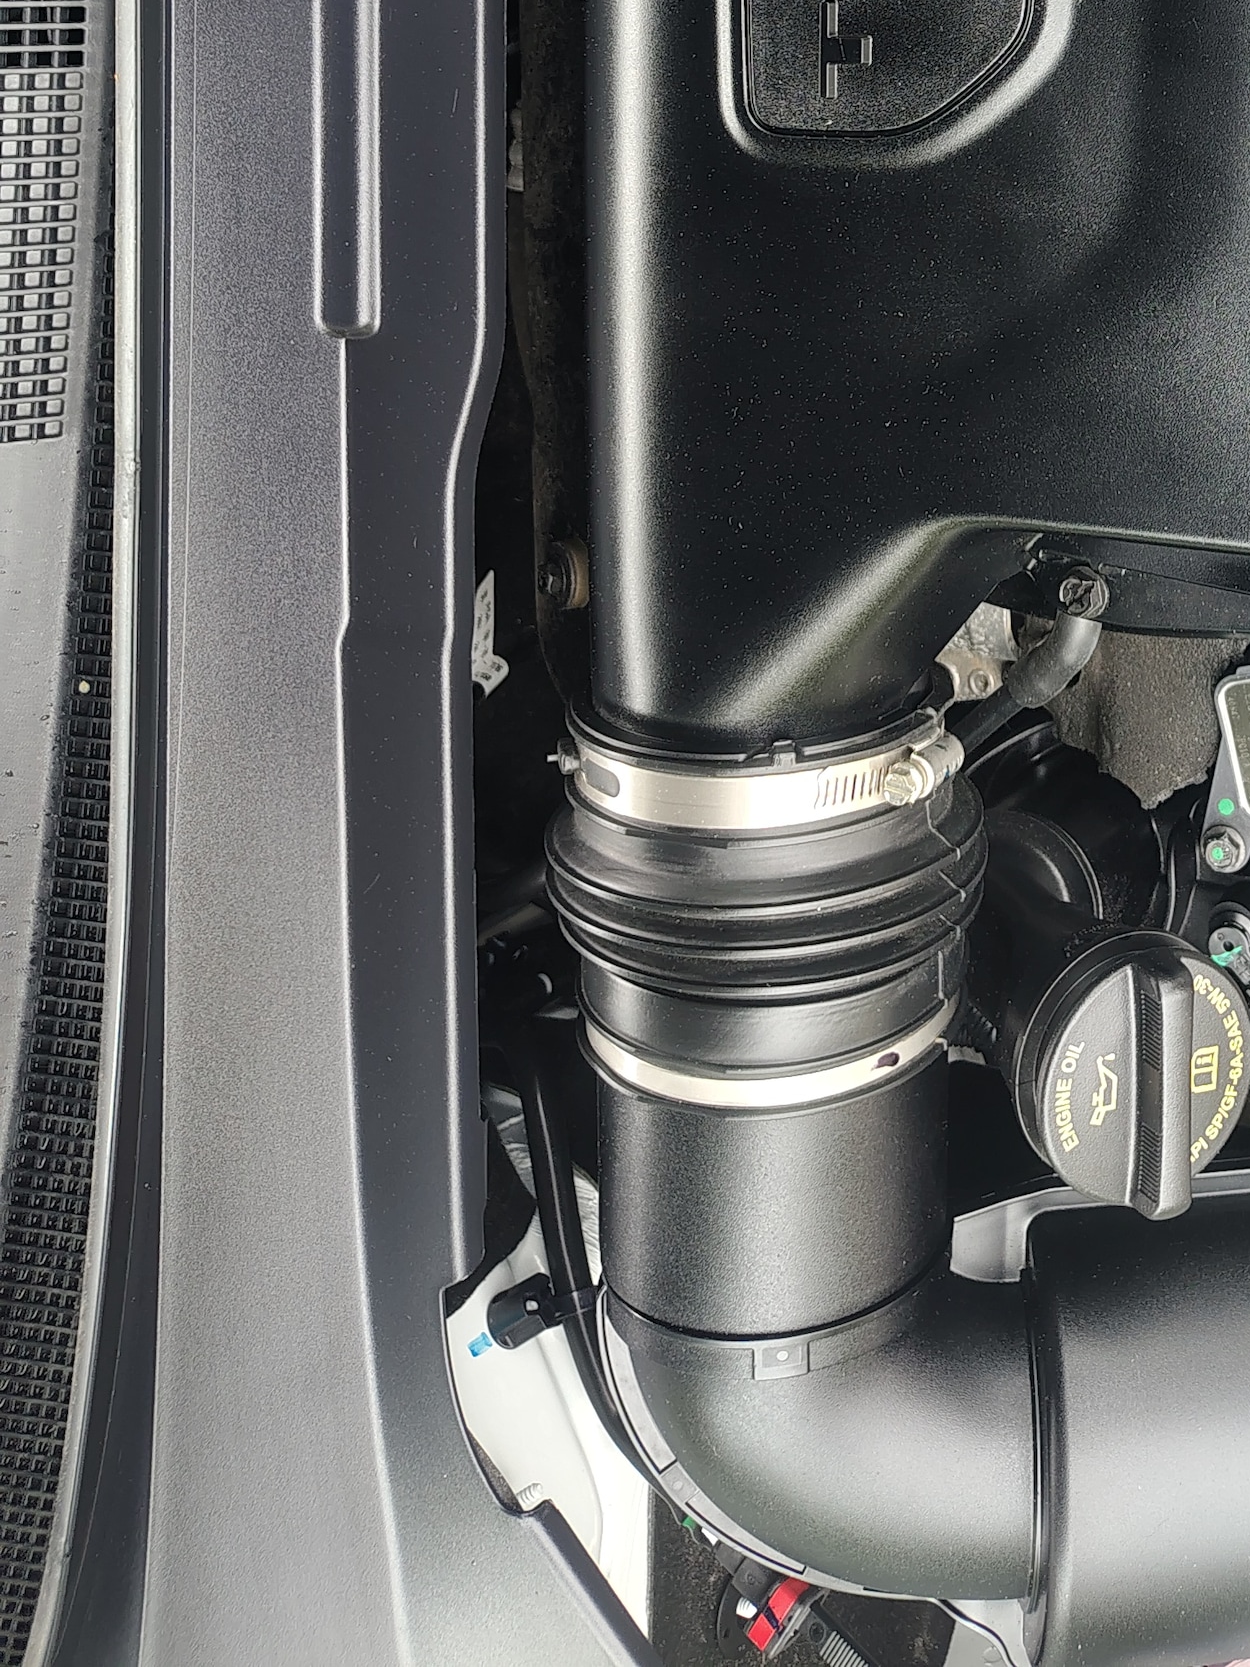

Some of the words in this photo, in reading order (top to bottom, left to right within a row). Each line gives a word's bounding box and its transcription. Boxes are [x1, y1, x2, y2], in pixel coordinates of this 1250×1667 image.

[1194, 974, 1231, 1015] 5W-30
[1061, 1041, 1085, 1074] OIL
[1205, 1010, 1244, 1140] SP/GF-6A-SAE
[1055, 1078, 1080, 1153] ENGINE
[1190, 1137, 1209, 1162] PI
